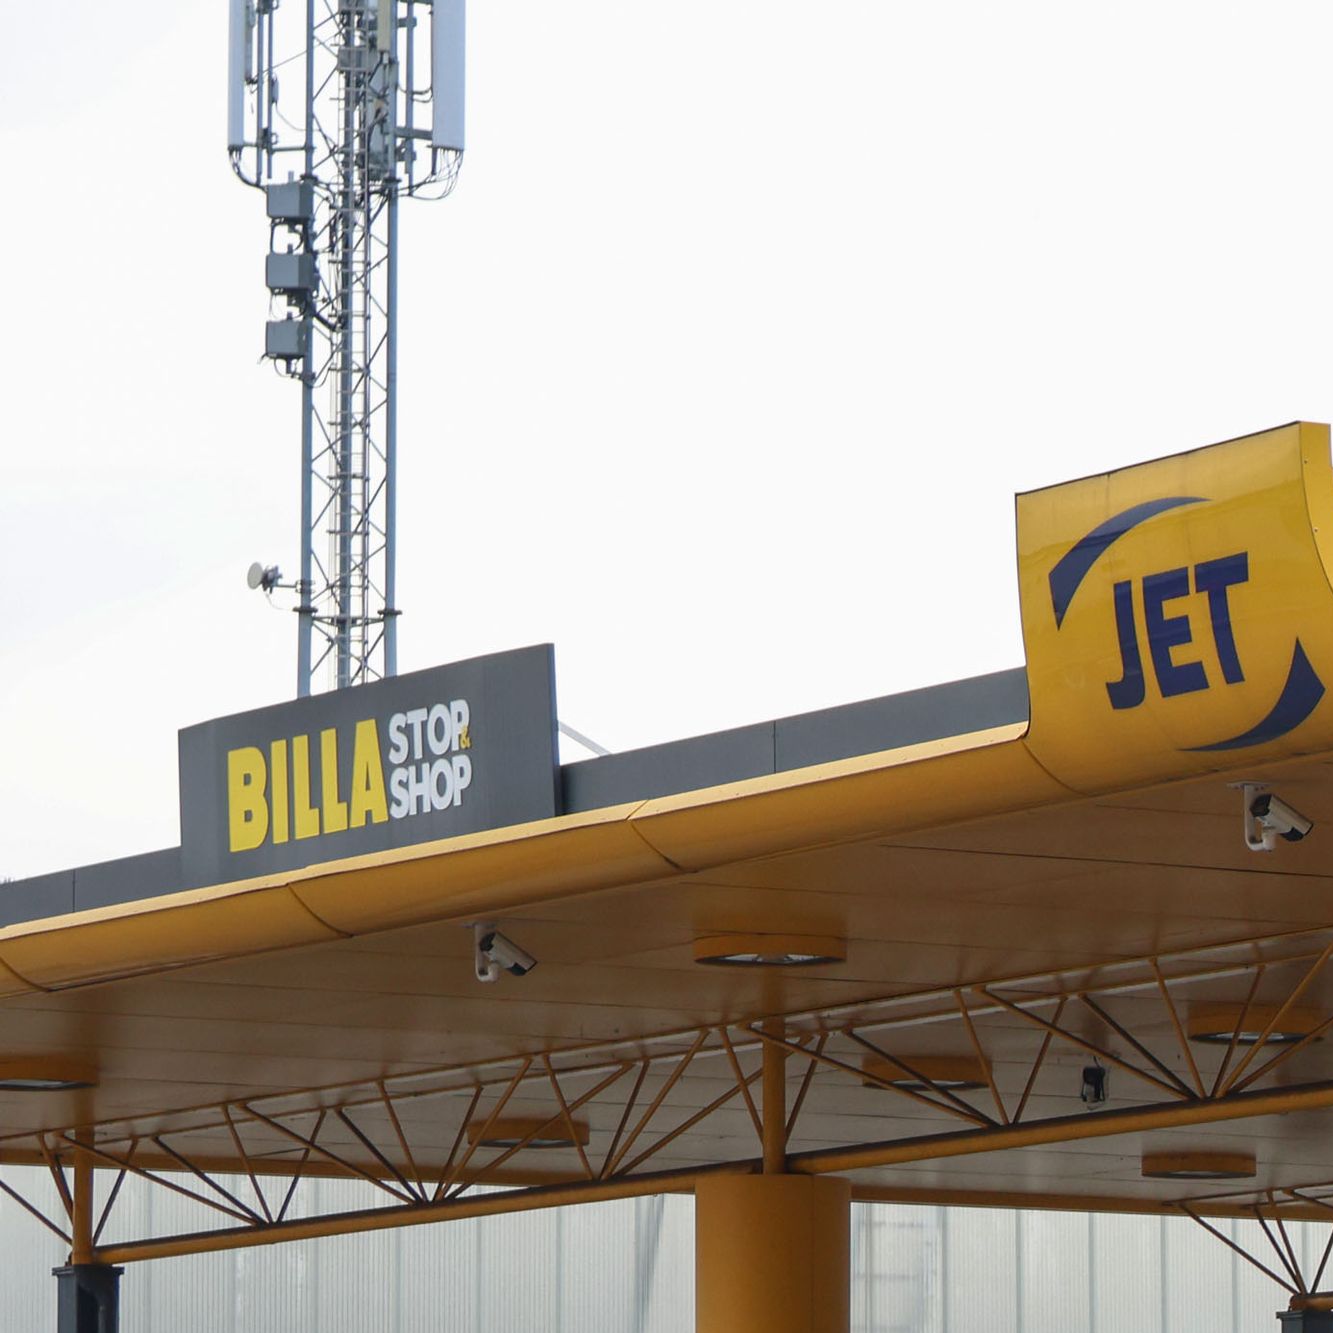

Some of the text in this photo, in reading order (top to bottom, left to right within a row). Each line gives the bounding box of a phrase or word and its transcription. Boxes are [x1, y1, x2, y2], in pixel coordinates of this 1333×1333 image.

[1105, 551, 1248, 710] JET
[227, 718, 388, 853] BILLA
[388, 754, 472, 819] SHOP
